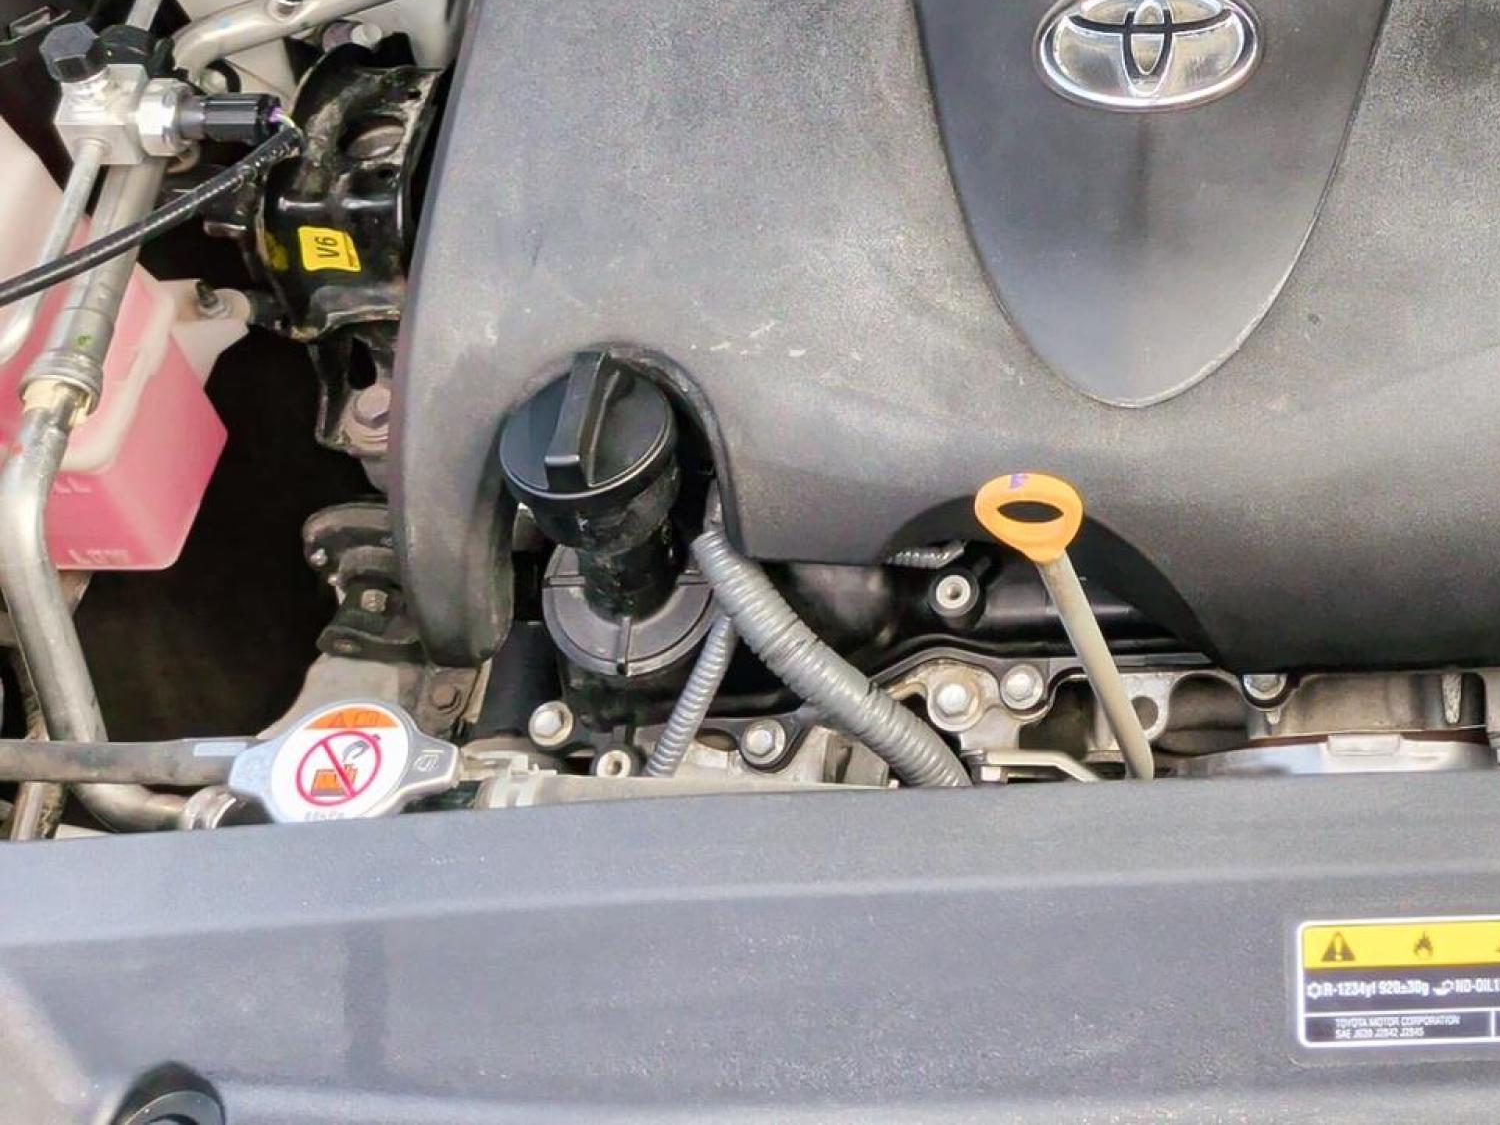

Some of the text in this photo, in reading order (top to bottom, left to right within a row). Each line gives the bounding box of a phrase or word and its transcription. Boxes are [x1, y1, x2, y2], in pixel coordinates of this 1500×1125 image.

[314, 236, 340, 259] V6
[1335, 1013, 1461, 1028] TOYOTA MOTOR CORPORATION
[1335, 1028, 1351, 1039] SAE
